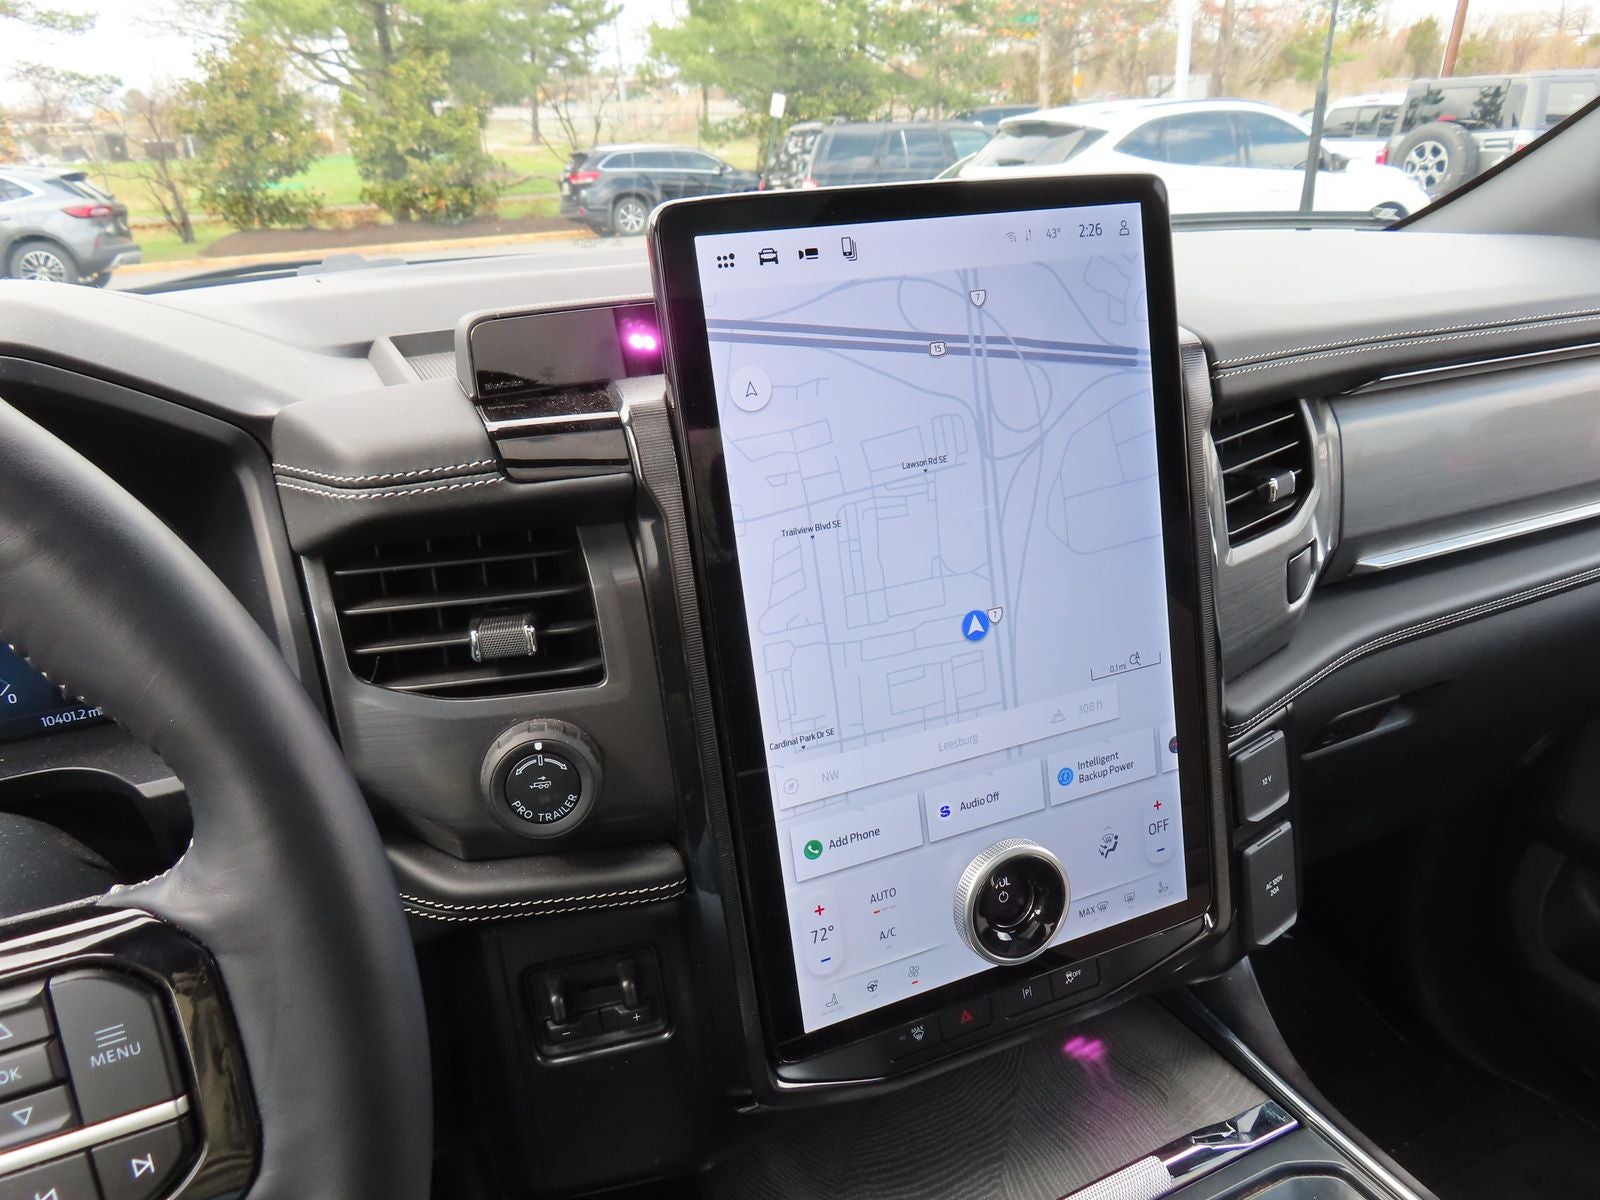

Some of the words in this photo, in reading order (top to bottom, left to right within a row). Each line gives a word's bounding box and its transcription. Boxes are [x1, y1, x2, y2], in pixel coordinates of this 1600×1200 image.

[1079, 223, 1103, 238] 2:26
[975, 293, 980, 301] 7
[934, 345, 942, 353] 15
[902, 459, 928, 469] Lawson
[928, 456, 938, 466] Rd
[938, 454, 948, 464] SE
[781, 526, 814, 537] Trailview
[815, 521, 831, 532] Blvd
[832, 519, 842, 528] SE
[7, 693, 18, 704] 0
[1077, 702, 1095, 715] 308
[1096, 700, 1104, 709] ft
[40, 708, 87, 728] 10401.2
[769, 736, 799, 750] Cardinal
[799, 732, 816, 743] Park
[816, 730, 825, 739] Dr
[825, 727, 835, 737] SE
[938, 734, 979, 752] Leesburg
[1077, 751, 1119, 771] Intelligent
[821, 769, 840, 782] NW
[1078, 768, 1108, 784] Backup
[1109, 760, 1134, 775] Power
[512, 800, 533, 819] PRO
[538, 793, 578, 822] TRAILER
[960, 797, 985, 811] Audio
[986, 791, 1000, 804] Off
[1148, 818, 1170, 836] OFF
[828, 835, 848, 850] Add
[850, 827, 881, 843] Phone
[870, 887, 897, 904] AUTO
[1078, 905, 1096, 918] MAX
[810, 925, 834, 944] 72°
[879, 927, 897, 941] A/C
[1072, 969, 1082, 978] OFF
[90, 1041, 141, 1068] MENU
[0, 1066, 22, 1085] OK
